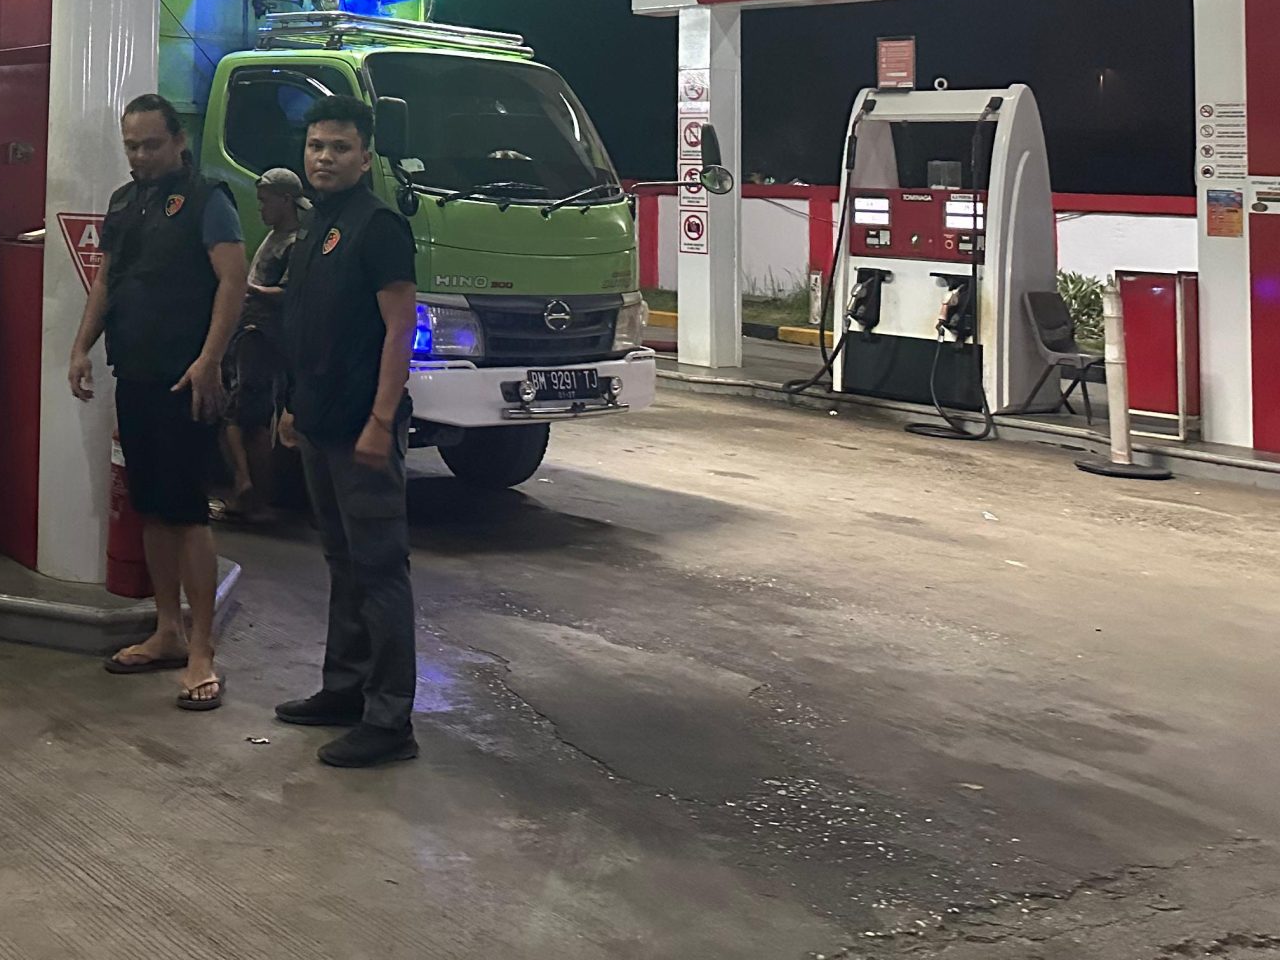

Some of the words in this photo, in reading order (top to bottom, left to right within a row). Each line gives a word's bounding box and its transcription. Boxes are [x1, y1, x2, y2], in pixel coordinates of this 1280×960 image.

[435, 275, 488, 288] HINO
[531, 370, 548, 391] BM
[551, 371, 578, 390] 9291
[583, 370, 598, 389] TJ
